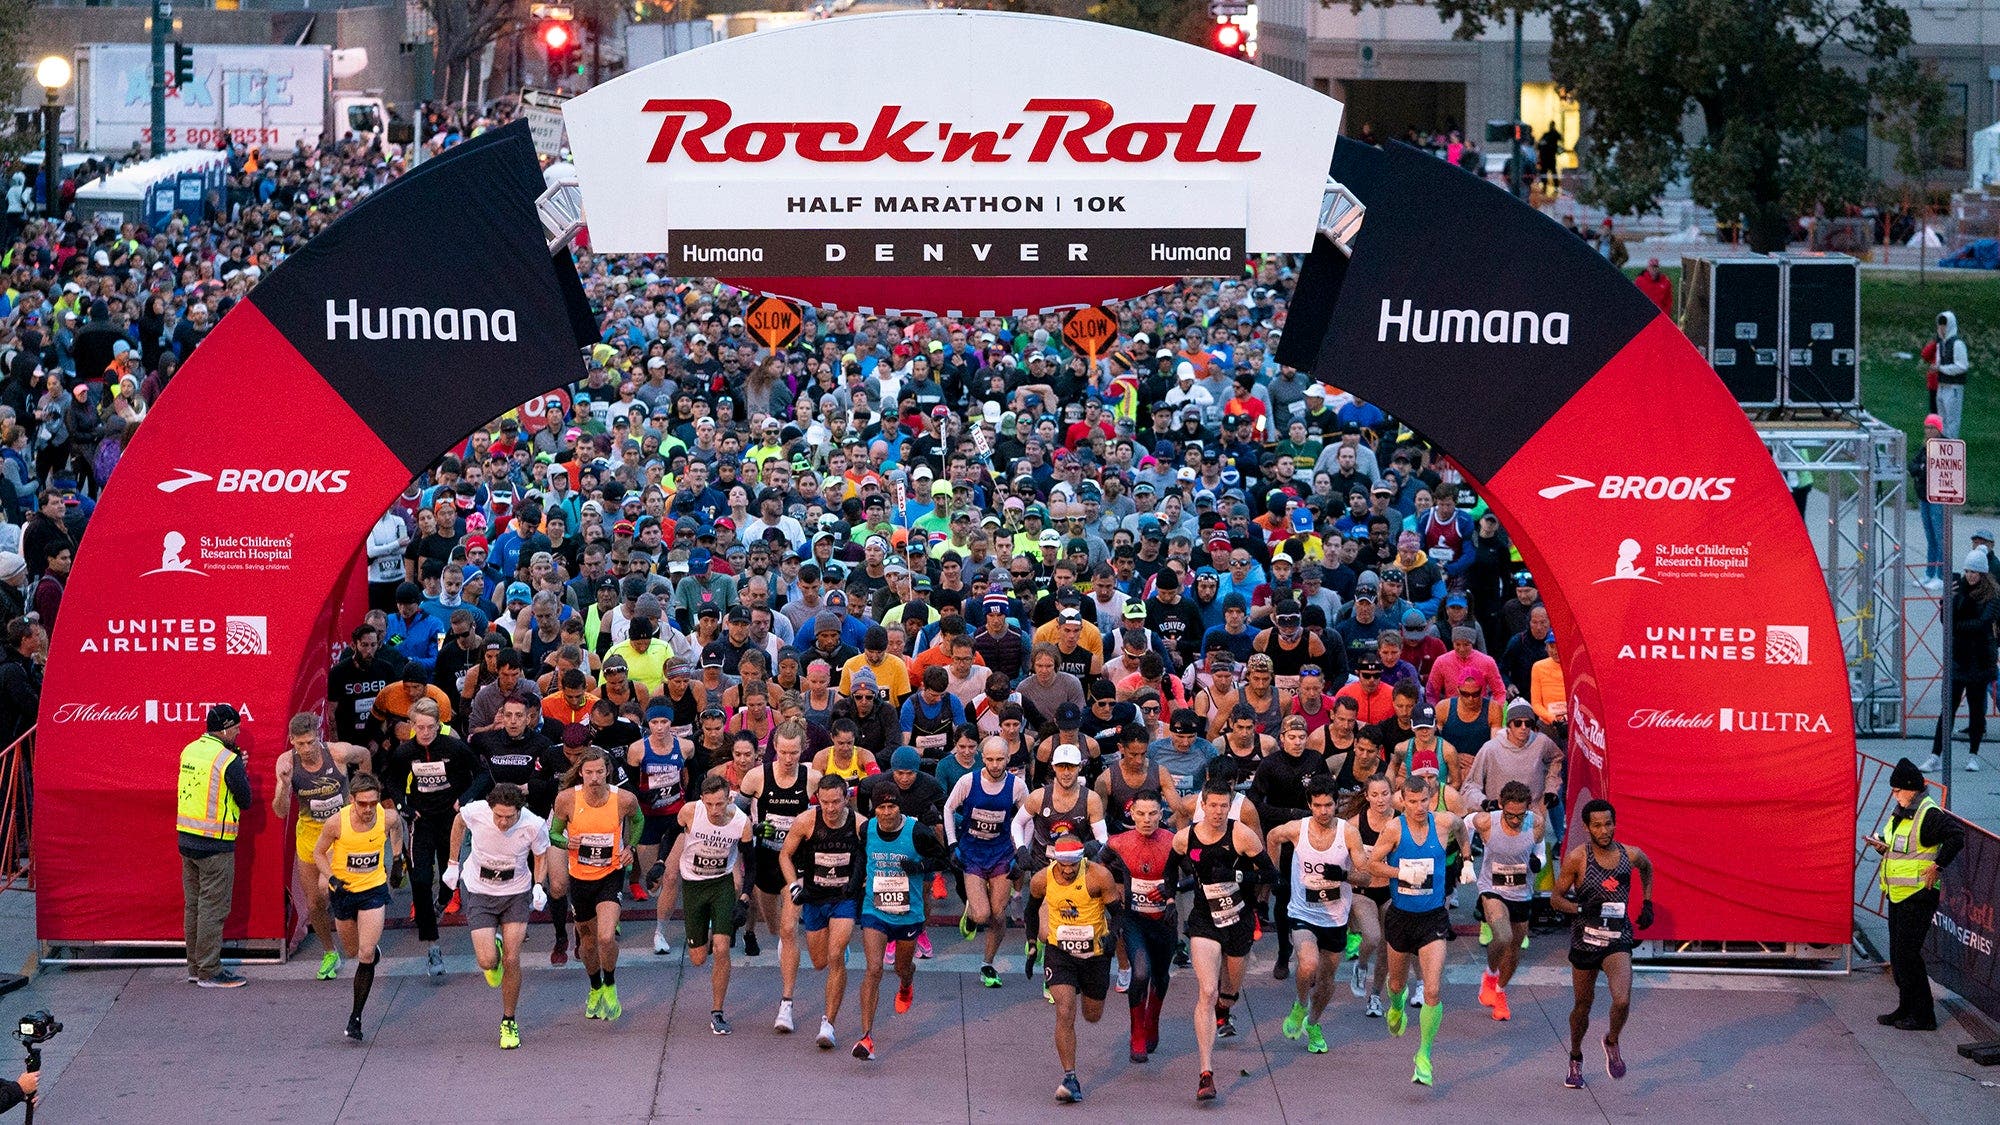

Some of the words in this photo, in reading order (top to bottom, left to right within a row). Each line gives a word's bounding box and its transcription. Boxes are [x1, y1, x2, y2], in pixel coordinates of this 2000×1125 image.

[140, 128, 176, 143] 33
[641, 99, 935, 163] Rock
[1022, 99, 1262, 163] Roll
[787, 196, 863, 213] HALF
[874, 196, 1044, 213] MARATHON
[1073, 196, 1126, 213] 10K
[683, 244, 763, 262] Humana
[825, 243, 1088, 262] DENVER
[1151, 244, 1231, 262] Humana
[326, 298, 517, 342] Humana
[754, 311, 792, 330] SLOW
[1377, 298, 1570, 345] Humana
[1069, 319, 1108, 339] SLOW
[1939, 444, 1954, 456] NO
[1930, 457, 1963, 471] PARKING
[216, 468, 351, 493] BROOKS
[1939, 471, 1953, 479] ANY
[1598, 476, 1737, 501] BROOKS
[1938, 479, 1954, 488] TIME
[200, 536, 214, 547] St.
[215, 536, 238, 549] Jude
[239, 536, 292, 548] Children's
[200, 548, 247, 559] Research
[248, 549, 292, 562] Hospital
[1655, 544, 1670, 555] St.
[1671, 544, 1695, 557] Jude
[1695, 544, 1749, 556] Children's
[1655, 556, 1702, 567] Research
[1703, 557, 1749, 570] Hospital
[108, 619, 216, 634] UNITED
[1158, 621, 1187, 632] DENVER
[1646, 627, 1756, 643] UNITED
[80, 638, 217, 653] AIRLINES
[1617, 645, 1756, 661] AIRLINES
[1066, 663, 1086, 673] FAST
[345, 681, 386, 694] SOBER
[52, 703, 140, 723] Michelob
[163, 702, 255, 722] ULTA
[1627, 709, 1715, 732] Michelob
[1737, 711, 1833, 733] ULTRA
[416, 775, 448, 785] 20039
[660, 787, 672, 797] 27
[976, 820, 997, 831] 1011
[695, 832, 738, 844] COLORADO
[590, 847, 603, 857] 13
[350, 856, 378, 868] 1004
[697, 857, 725, 867] 1003
[494, 870, 501, 878] 7
[828, 867, 836, 876] 4
[1505, 874, 1514, 884] 11
[879, 892, 905, 902] 1018
[1318, 889, 1327, 899] 6
[1219, 896, 1234, 907] 28
[1061, 941, 1090, 951] 1068
[1956, 926, 1991, 955] SERIES
